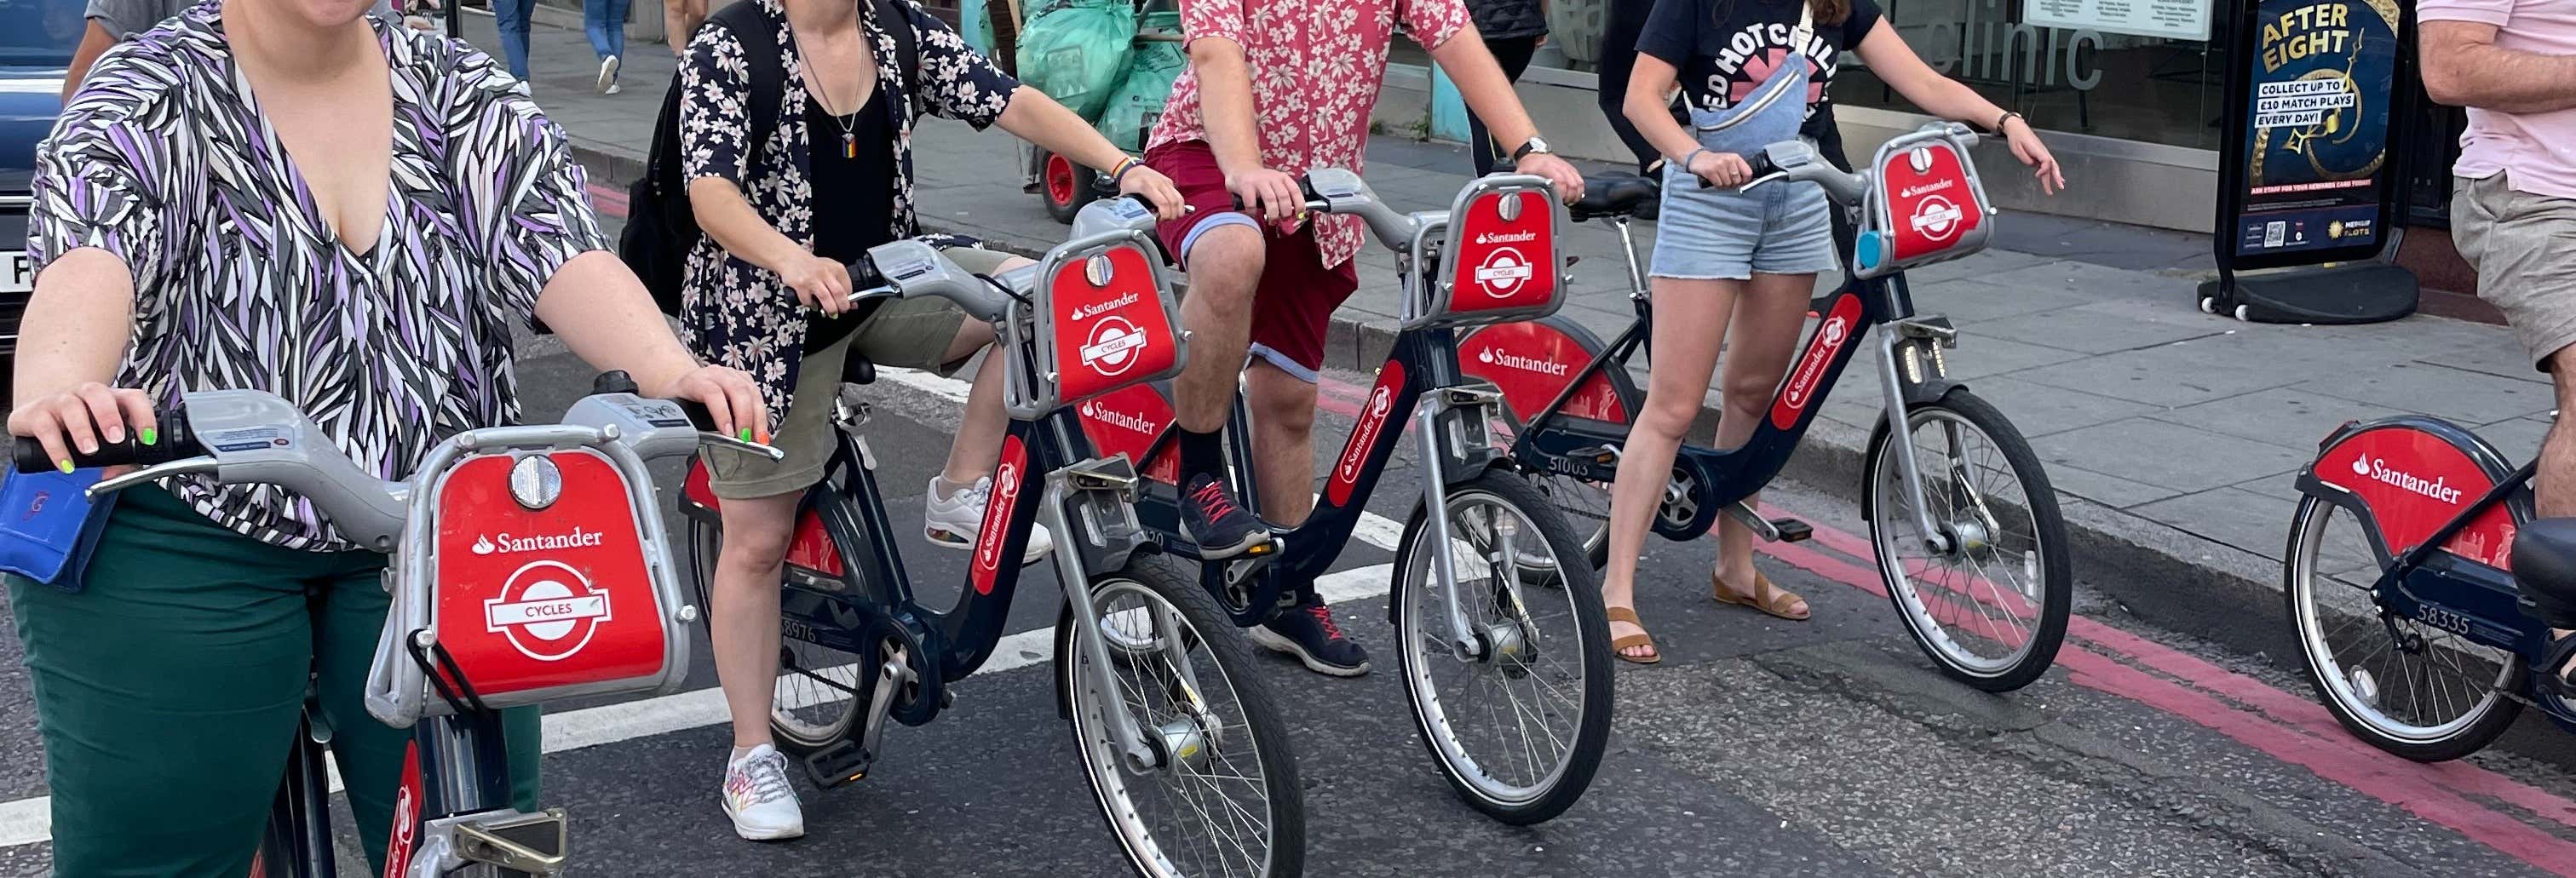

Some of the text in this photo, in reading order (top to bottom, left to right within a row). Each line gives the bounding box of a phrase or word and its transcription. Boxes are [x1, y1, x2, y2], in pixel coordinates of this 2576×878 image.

[2263, 3, 2349, 50] AFTER
[1715, 22, 1765, 75] HOT
[2263, 29, 2350, 74] EIGHT
[1703, 74, 1728, 112] ED
[2262, 81, 2340, 95] COLLECT UP TO
[2260, 95, 2352, 111] £10 MATCH PLAYS
[2257, 112, 2318, 126] EVERY DAY!
[1910, 177, 1953, 197] Santander
[1486, 229, 1536, 244] Santander
[1084, 291, 1139, 318] Santander
[1101, 340, 1126, 353] CYCLES
[1495, 347, 1568, 376] Santander
[1794, 346, 1826, 393] Santander
[1095, 401, 1156, 435] Santander
[1348, 417, 1375, 467] Santander
[2371, 458, 2462, 504] Santander
[986, 496, 1005, 550] Santander
[497, 526, 603, 554] Santander
[525, 603, 572, 618] CYCLES
[2416, 603, 2470, 634] 58335
[782, 619, 816, 643] 8976
